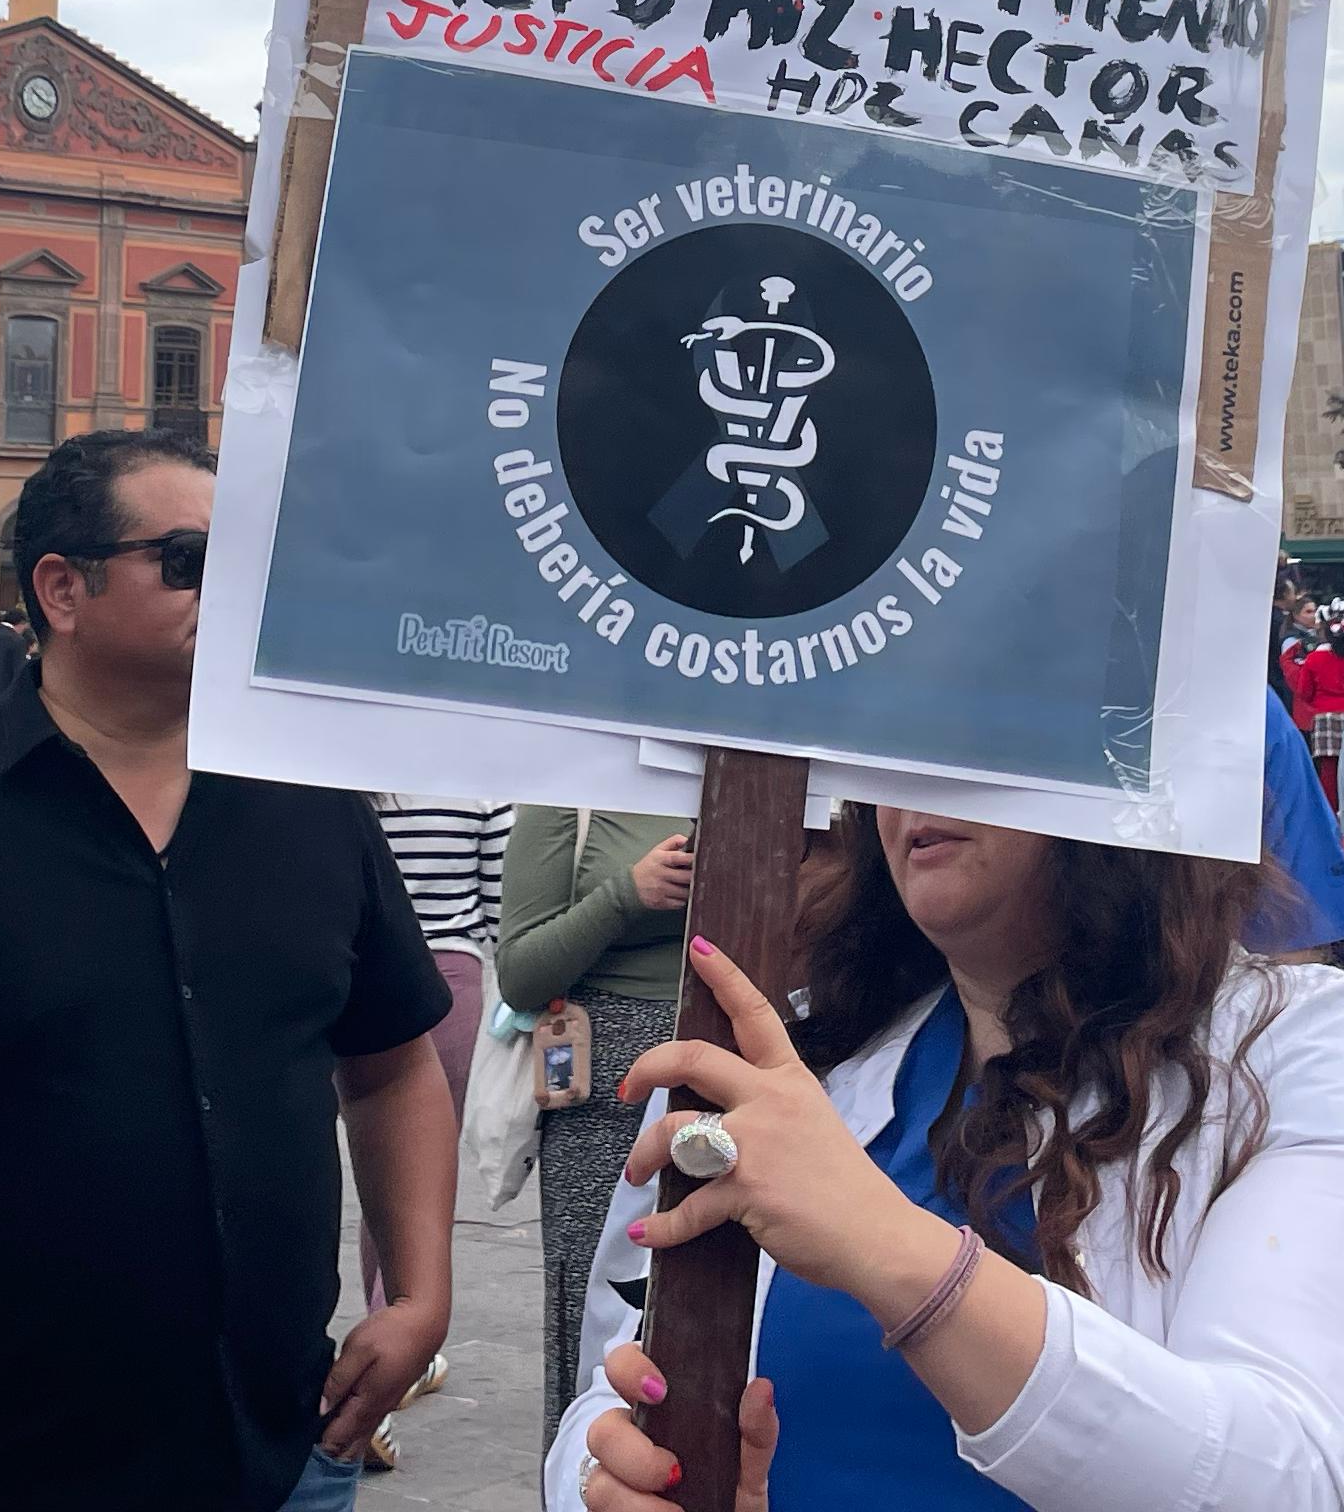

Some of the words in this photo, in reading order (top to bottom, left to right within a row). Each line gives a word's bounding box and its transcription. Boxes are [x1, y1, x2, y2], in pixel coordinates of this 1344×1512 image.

[766, 59, 922, 127] HDZ
[882, 5, 1226, 126] HECTOR
[578, 193, 665, 267] Ser
[676, 164, 933, 302] veterinario
[488, 358, 548, 428] No
[1220, 271, 1244, 452] www.teka.com
[941, 429, 1004, 540] vida
[494, 449, 634, 645] debería
[896, 547, 963, 606] la
[487, 625, 570, 673] Resort
[645, 594, 913, 685] costarnos
